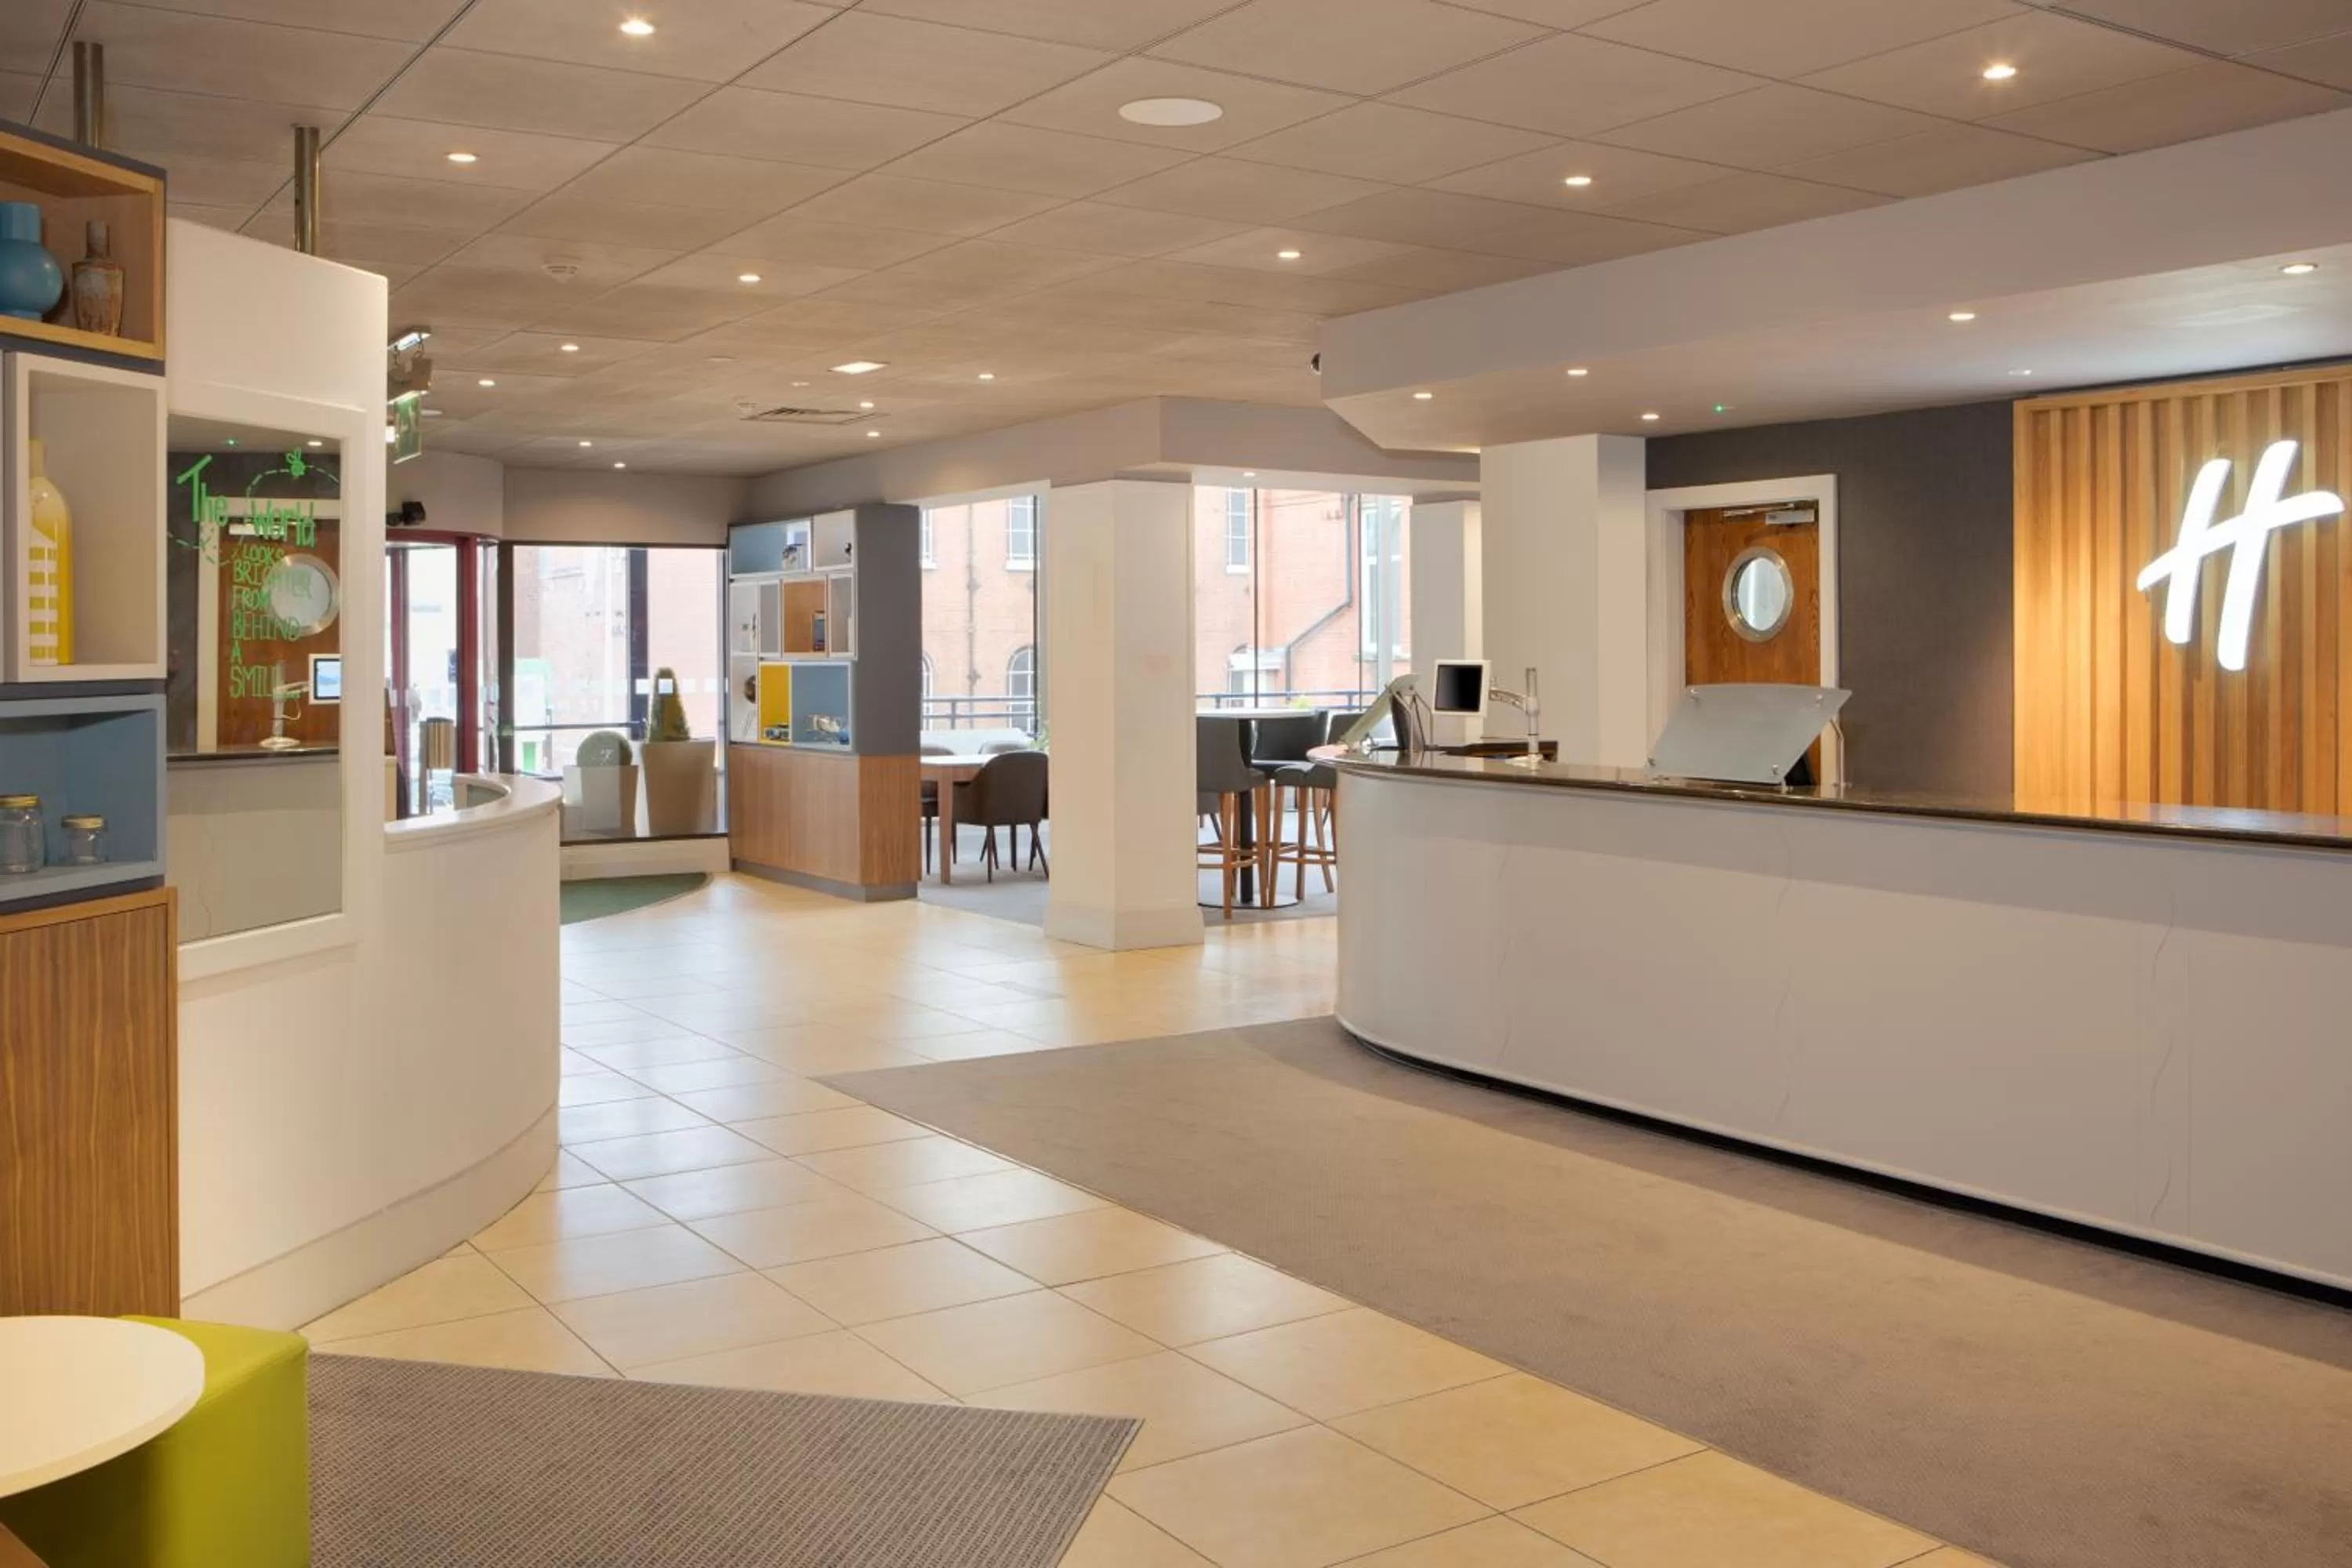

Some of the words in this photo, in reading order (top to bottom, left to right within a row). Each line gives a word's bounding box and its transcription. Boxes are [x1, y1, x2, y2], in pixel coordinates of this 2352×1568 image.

[176, 454, 228, 528] The
[251, 500, 317, 547] World
[2136, 440, 2345, 671] H
[232, 585, 270, 609] FROM
[232, 609, 301, 641] BEHIND
[231, 640, 241, 665] A
